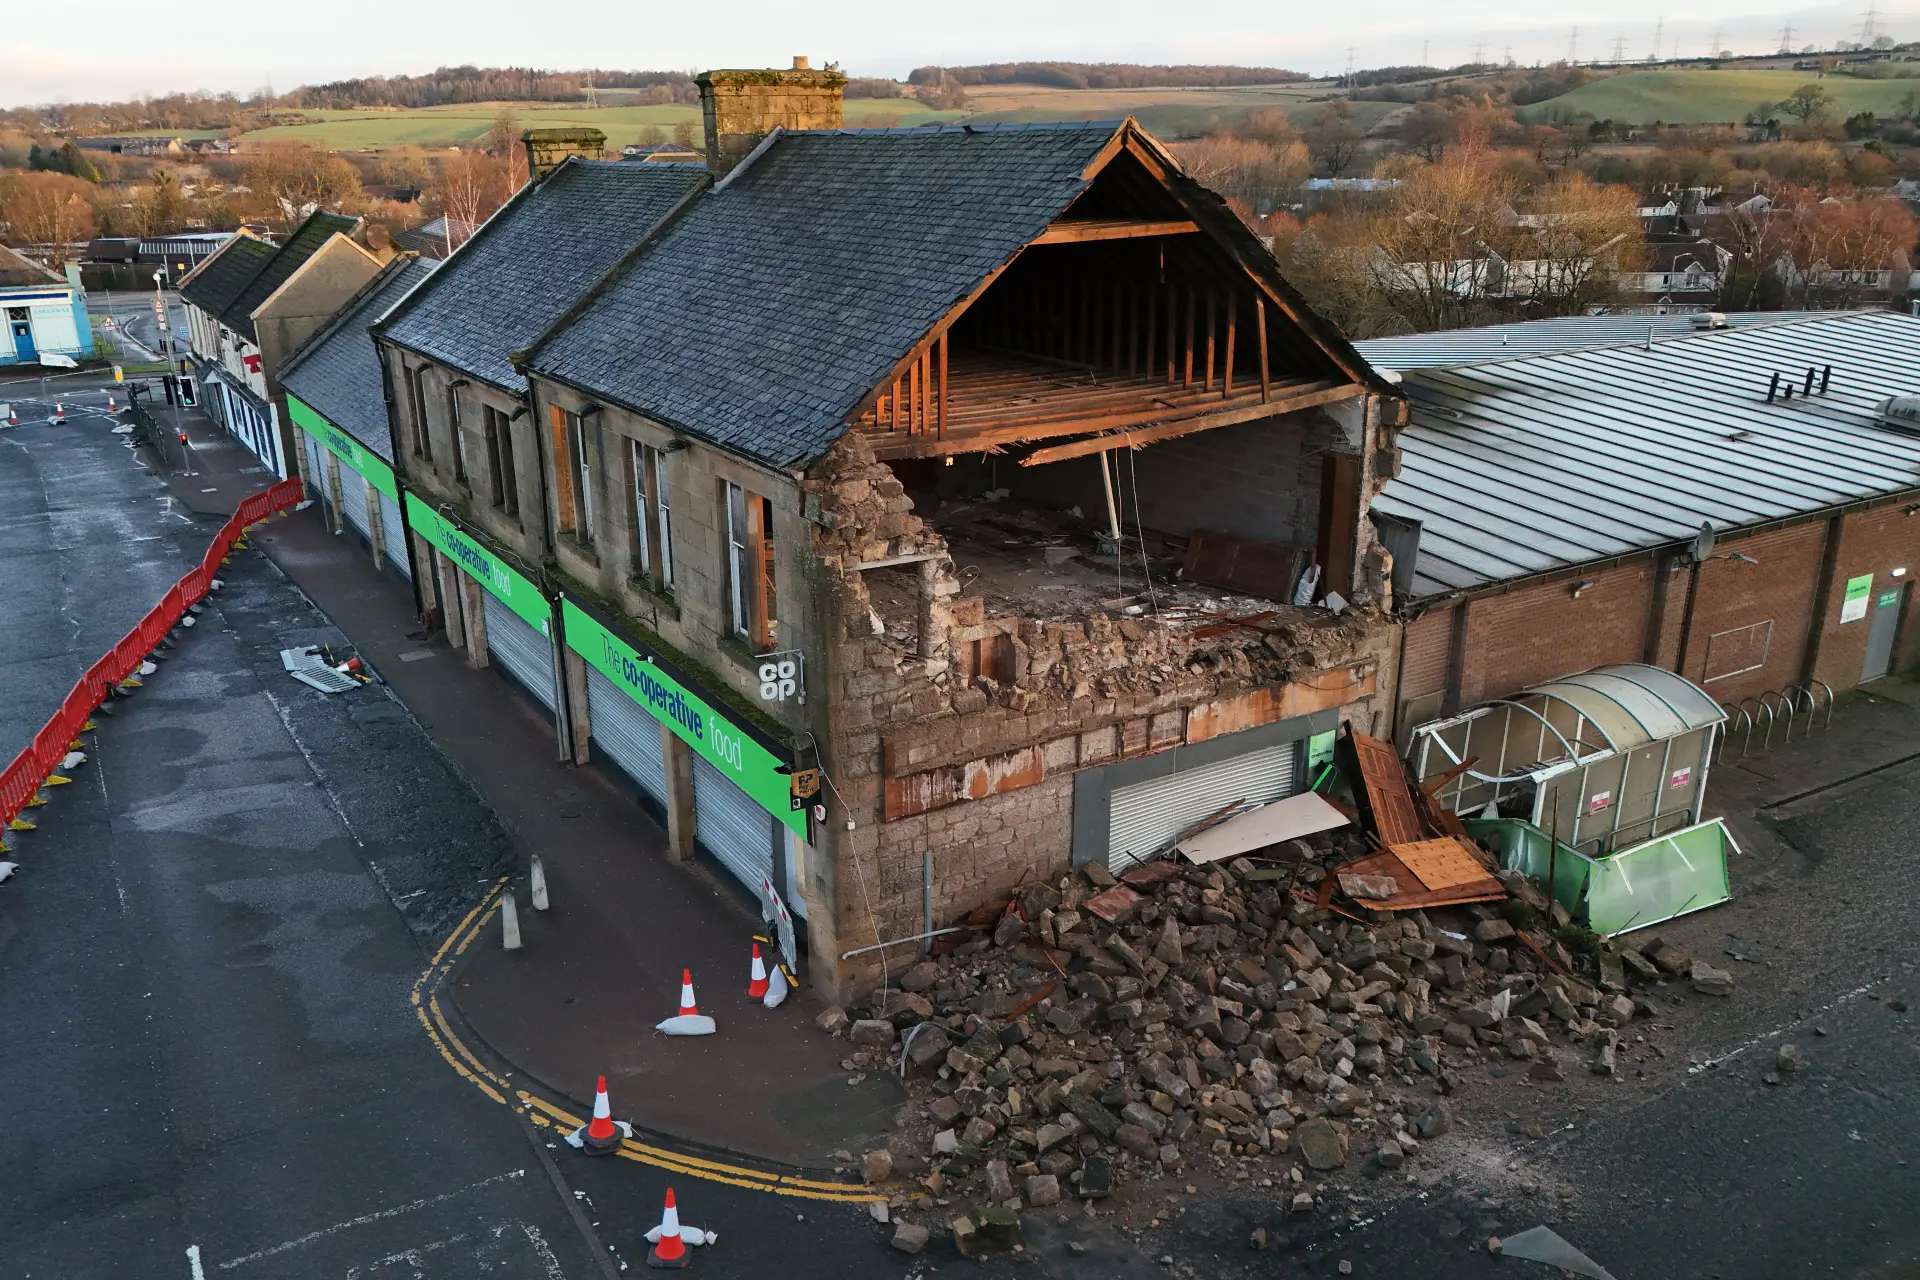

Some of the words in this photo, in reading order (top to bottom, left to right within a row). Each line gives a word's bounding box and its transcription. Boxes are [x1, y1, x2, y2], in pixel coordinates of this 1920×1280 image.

[433, 516, 446, 545] The
[446, 531, 491, 581] co-operative
[492, 560, 512, 597] food
[600, 632, 621, 674] The
[622, 656, 703, 740] co-operative
[709, 716, 742, 773] food
